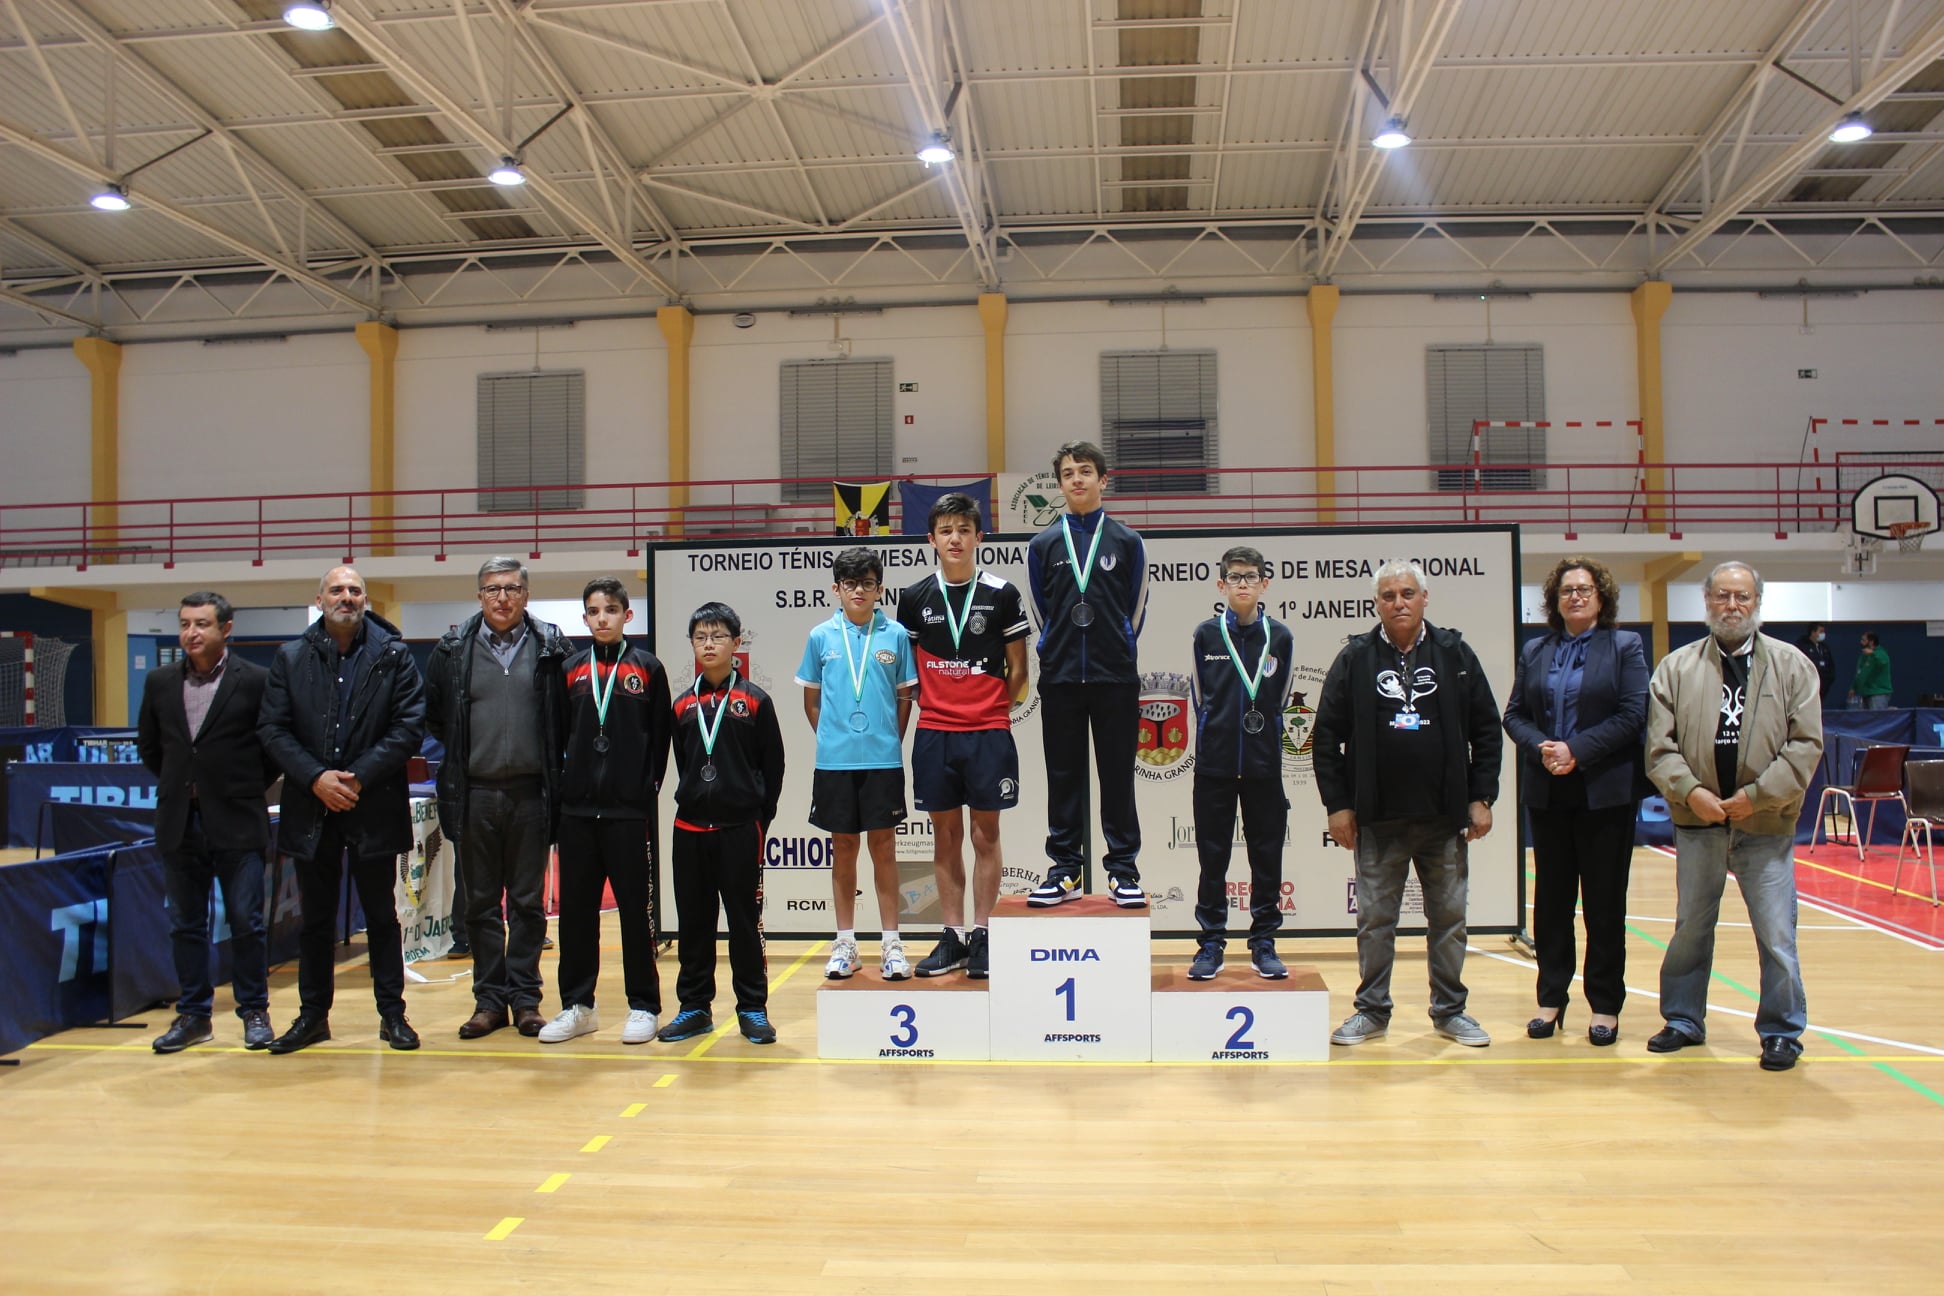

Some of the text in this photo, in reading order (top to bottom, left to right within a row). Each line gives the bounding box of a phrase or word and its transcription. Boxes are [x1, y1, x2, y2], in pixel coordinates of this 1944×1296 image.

[1027, 477, 1035, 485] DE
[687, 552, 773, 572] TORNEIO
[778, 547, 834, 570] TÉNIS
[1149, 562, 1210, 582] RNEIO
[1281, 561, 1309, 579] DE
[1315, 559, 1373, 579] MESA
[775, 589, 831, 609] S.B.R.
[1278, 601, 1297, 619] 1º
[1302, 599, 1377, 619] JANEIR
[1300, 664, 1328, 676] Benefic
[1134, 764, 1163, 781] RINHA
[895, 818, 934, 835] ant
[1001, 866, 1041, 885] BERNA
[1030, 948, 1101, 961] DIMA
[1055, 977, 1075, 1021] 1
[890, 1004, 919, 1048] 3
[1225, 1005, 1255, 1050] 2
[1044, 1033, 1101, 1043] AFFSPORTS
[878, 1048, 935, 1058] AFFSPORTS
[1211, 1051, 1270, 1060] AFFSPORTS
